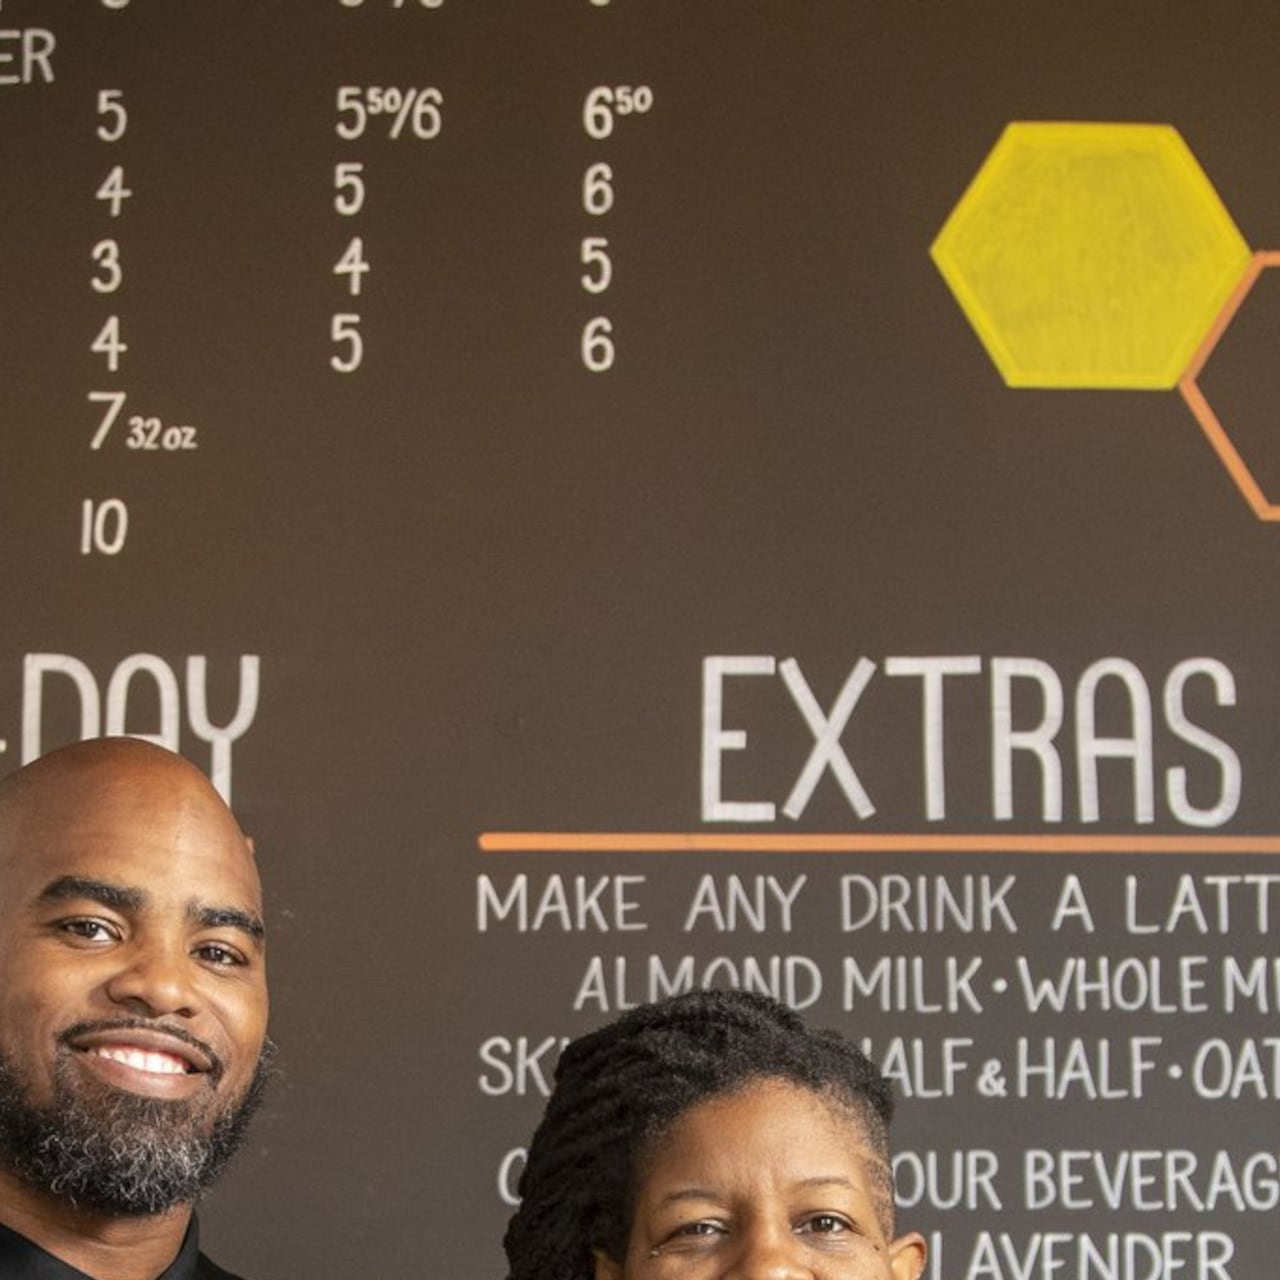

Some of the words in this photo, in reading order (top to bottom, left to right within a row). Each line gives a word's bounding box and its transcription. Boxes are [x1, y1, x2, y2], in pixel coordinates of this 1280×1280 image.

[97, 89, 127, 142] 5
[96, 165, 132, 216] 4
[335, 163, 365, 216] 5
[583, 162, 614, 215] 6
[91, 239, 122, 293] 3
[333, 237, 370, 295] 4
[581, 237, 612, 294] 5
[91, 315, 128, 372] 4
[331, 313, 363, 373] 5
[581, 316, 615, 372] 6
[88, 391, 126, 450] 7
[81, 498, 128, 555] 10
[701, 655, 1242, 828] EXTRAS
[477, 873, 647, 932] MAKE
[684, 874, 807, 933] ANY
[840, 874, 1018, 933] DRINK
[1052, 874, 1095, 933] A
[573, 954, 823, 1013] ALMOND
[843, 956, 983, 1013] MILK
[1017, 956, 1208, 1013] WHOLE
[477, 1034, 571, 1098] SK
[861, 1036, 974, 1099] ALF
[1018, 1036, 1162, 1100] HALF
[891, 1149, 1003, 1211] OUR
